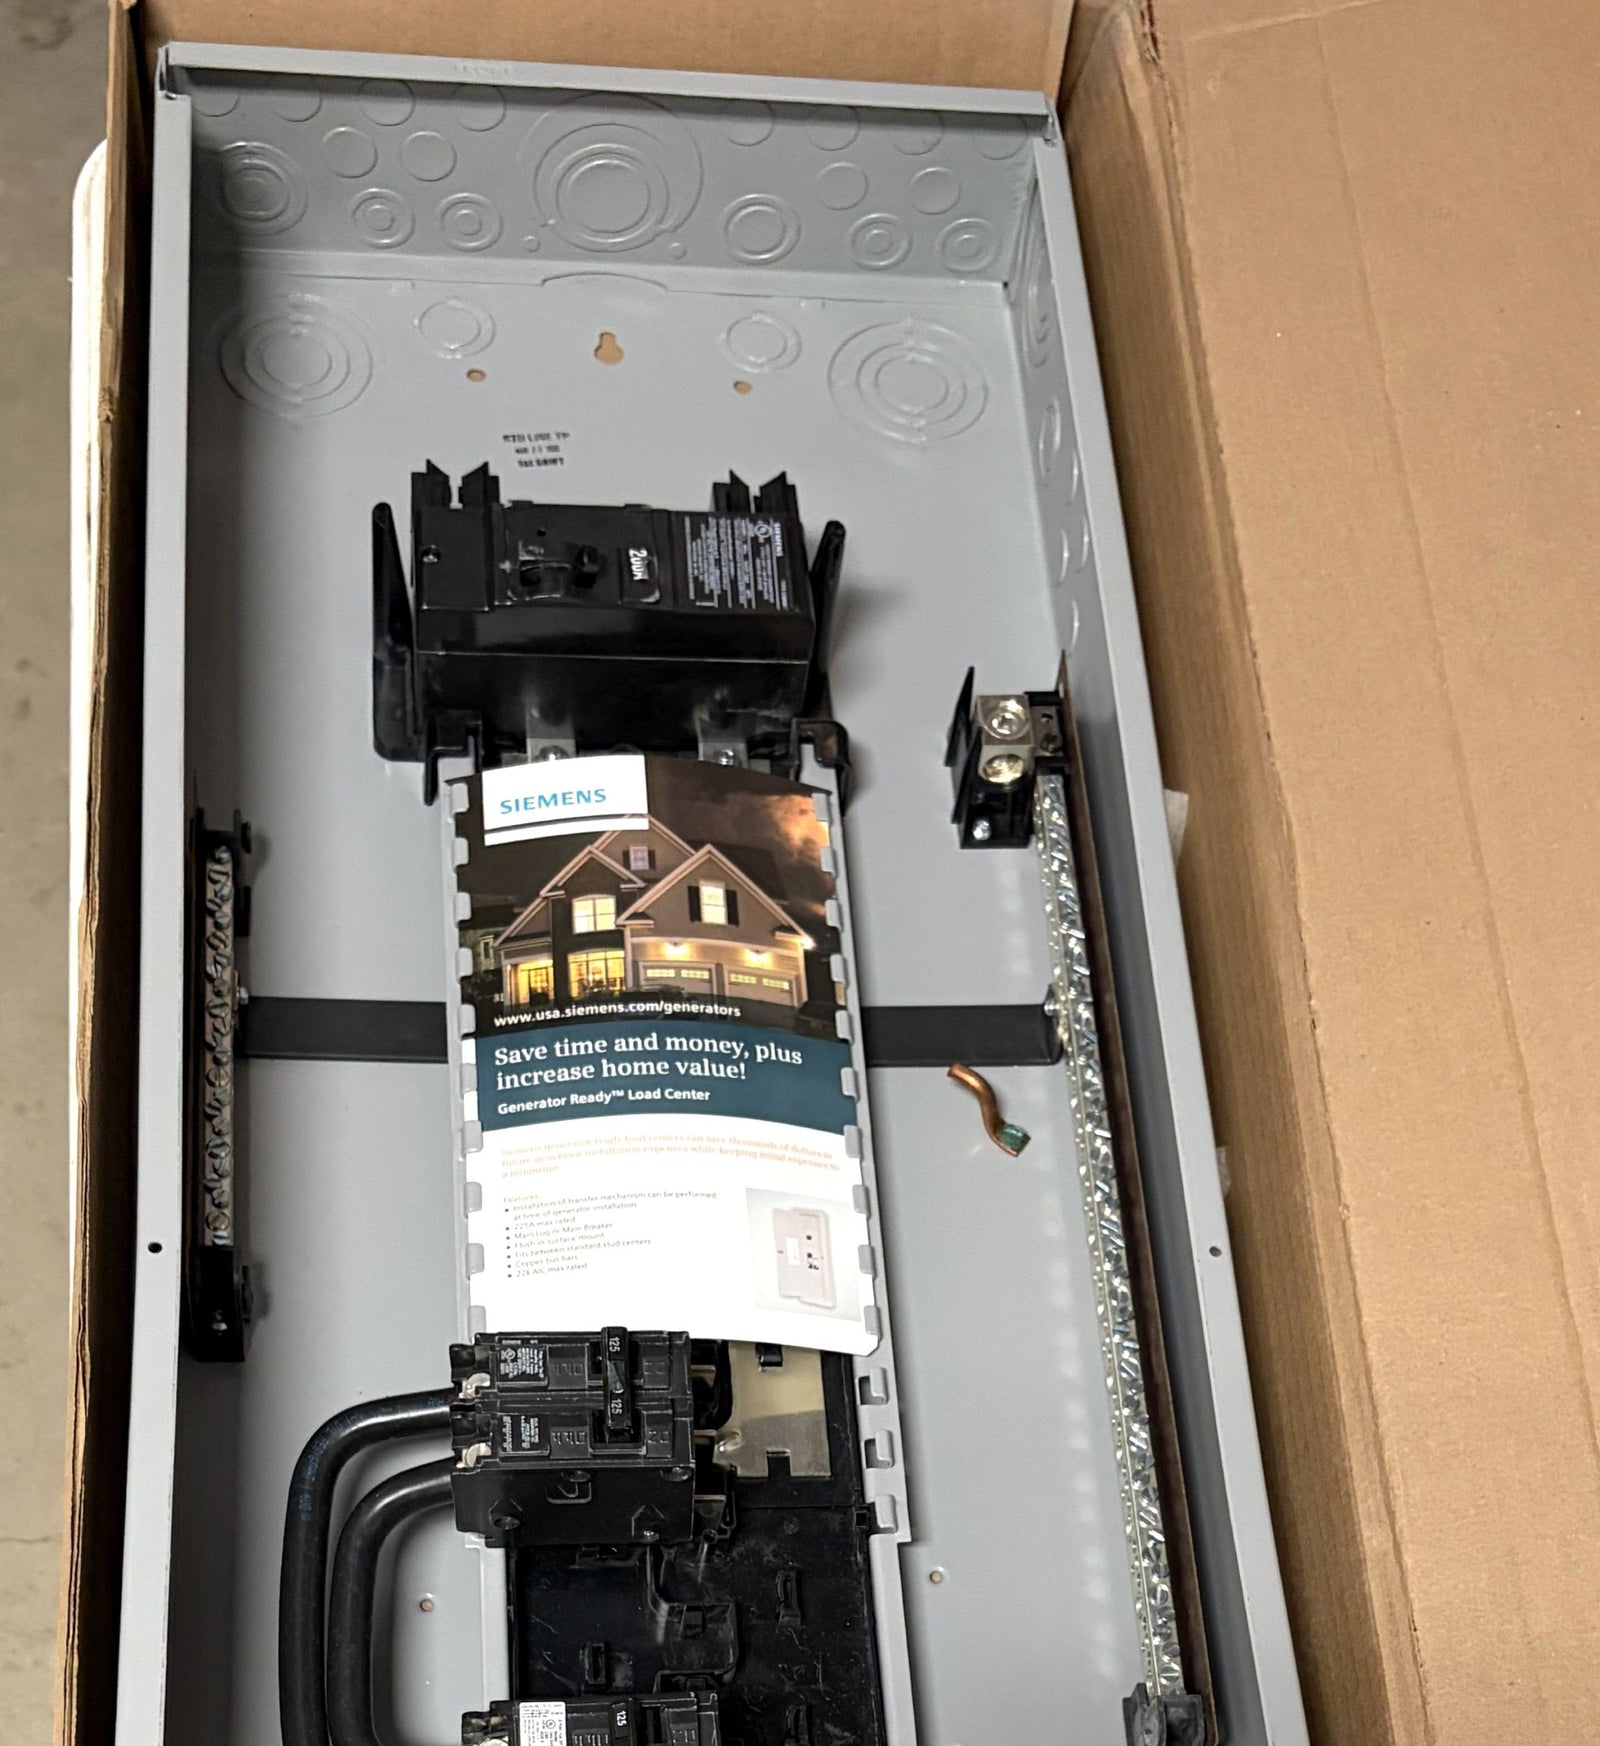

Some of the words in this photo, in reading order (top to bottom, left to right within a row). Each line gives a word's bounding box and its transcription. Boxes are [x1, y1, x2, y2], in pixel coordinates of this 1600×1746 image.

[500, 788, 607, 815] SIEMENS
[494, 1000, 741, 1027] www.usa.siemens.com/generators
[495, 1046, 547, 1065] Save
[554, 1039, 607, 1057] time
[614, 1033, 659, 1051] and
[666, 1037, 749, 1059] money,
[756, 1043, 802, 1064] plus
[496, 1063, 594, 1090] increase
[602, 1059, 669, 1077] home
[675, 1059, 747, 1079] value!
[498, 1098, 566, 1114] Generator
[628, 1088, 661, 1100] Load
[665, 1089, 710, 1100] Center
[608, 1337, 620, 1353] 125
[610, 1399, 622, 1415] 125
[616, 1710, 628, 1727] 125
